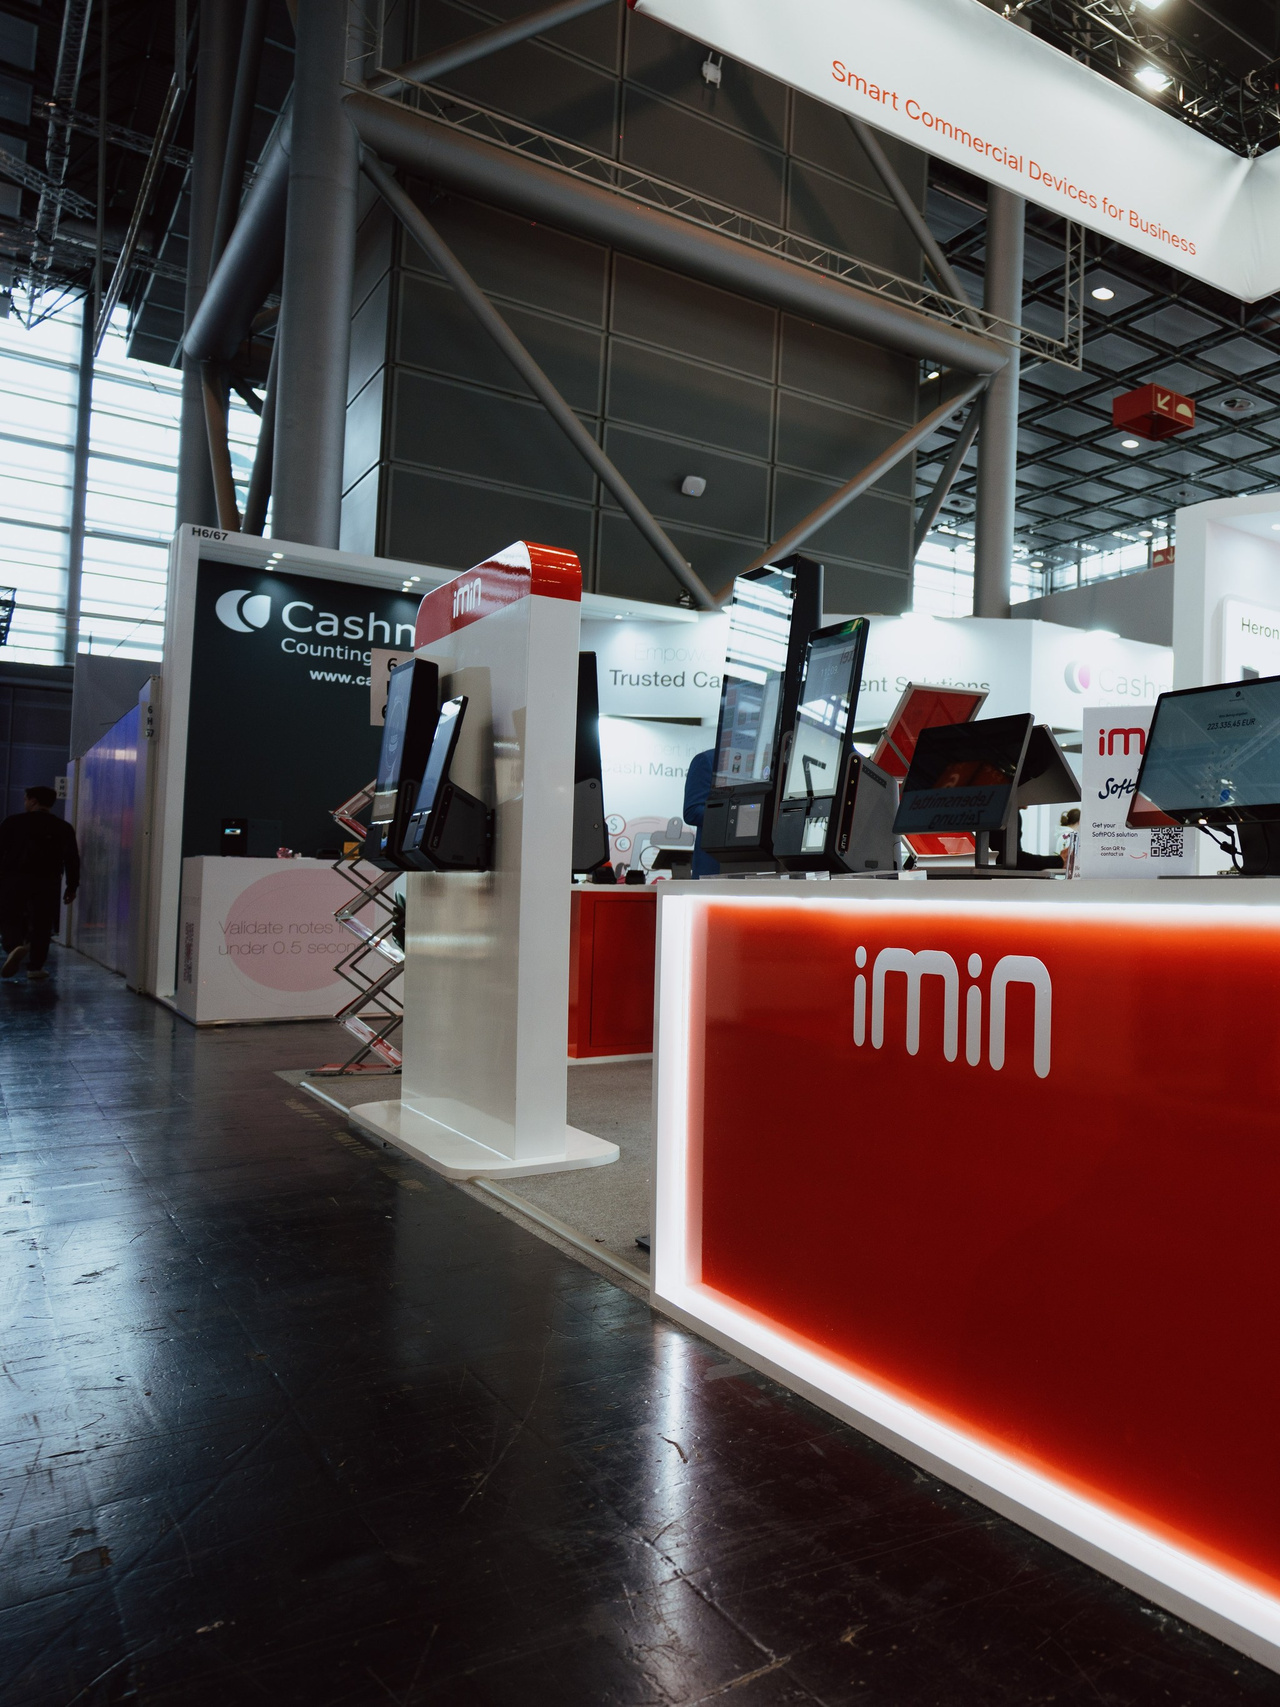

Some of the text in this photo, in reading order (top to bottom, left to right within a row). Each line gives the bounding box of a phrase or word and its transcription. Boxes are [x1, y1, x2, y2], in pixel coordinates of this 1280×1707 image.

[831, 60, 1197, 256] Smart Commercial Devices for Business
[191, 526, 229, 541] H6/67
[1241, 617, 1280, 641] Heron
[281, 637, 372, 666] Counting
[609, 669, 721, 689] Trusted Ca
[1242, 717, 1256, 726] EUR
[218, 920, 283, 935] Validate
[289, 921, 334, 934] notes
[218, 941, 268, 956] under
[273, 941, 302, 955] 0.5
